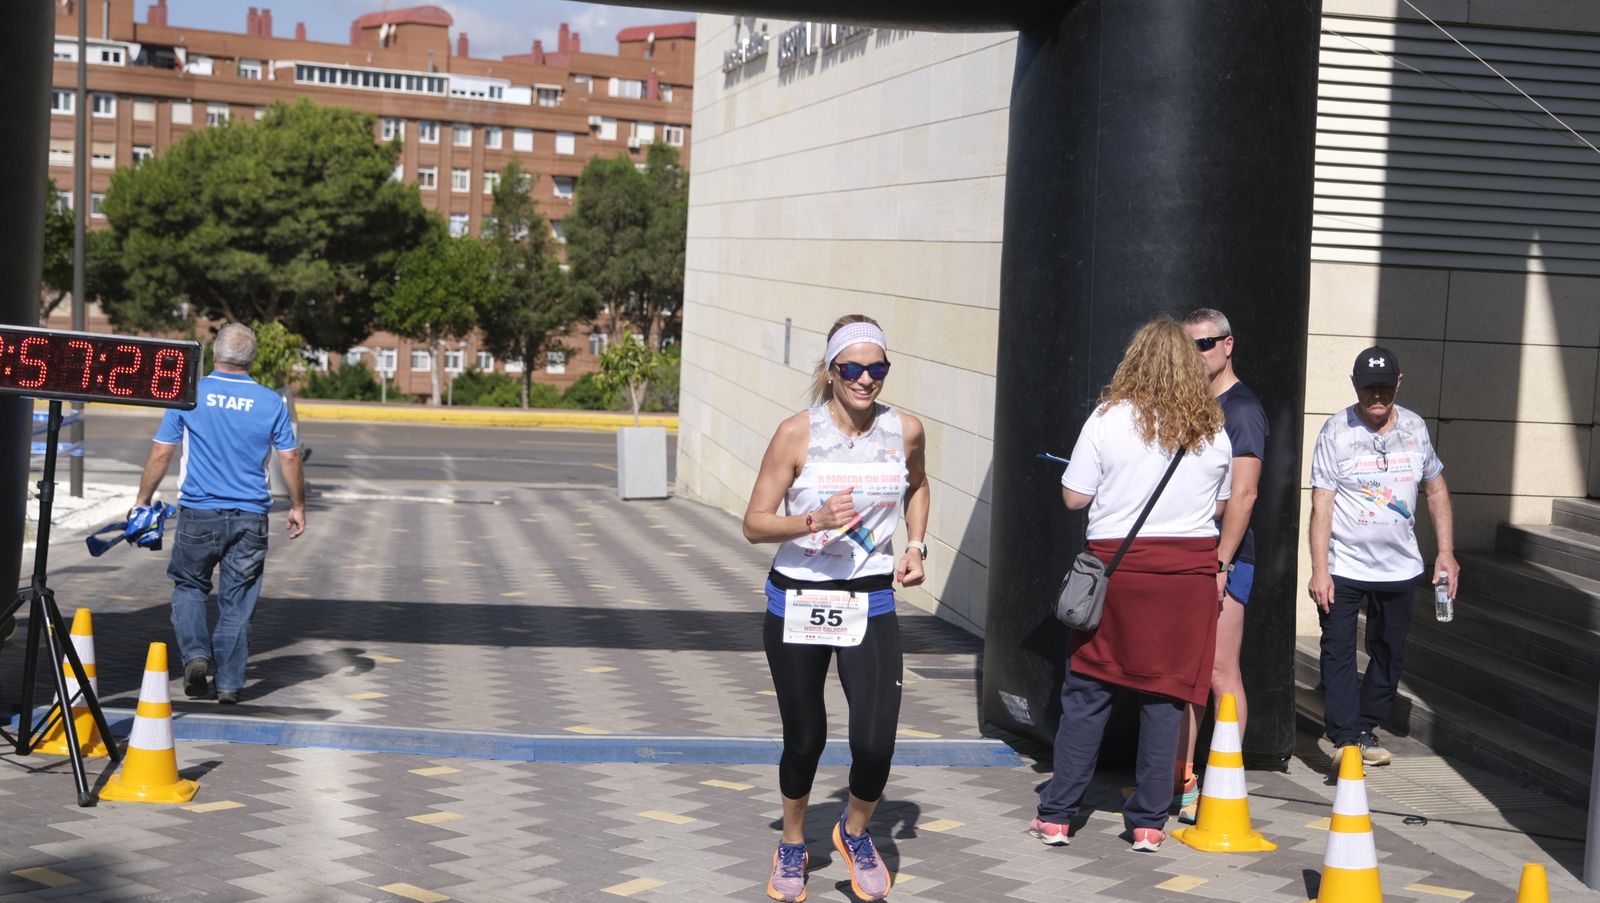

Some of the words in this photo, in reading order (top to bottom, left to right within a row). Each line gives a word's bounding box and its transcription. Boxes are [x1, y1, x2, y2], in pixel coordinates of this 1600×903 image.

[0, 335, 184, 399] :57:28
[206, 393, 255, 412] STAFF
[809, 608, 843, 627] 55
